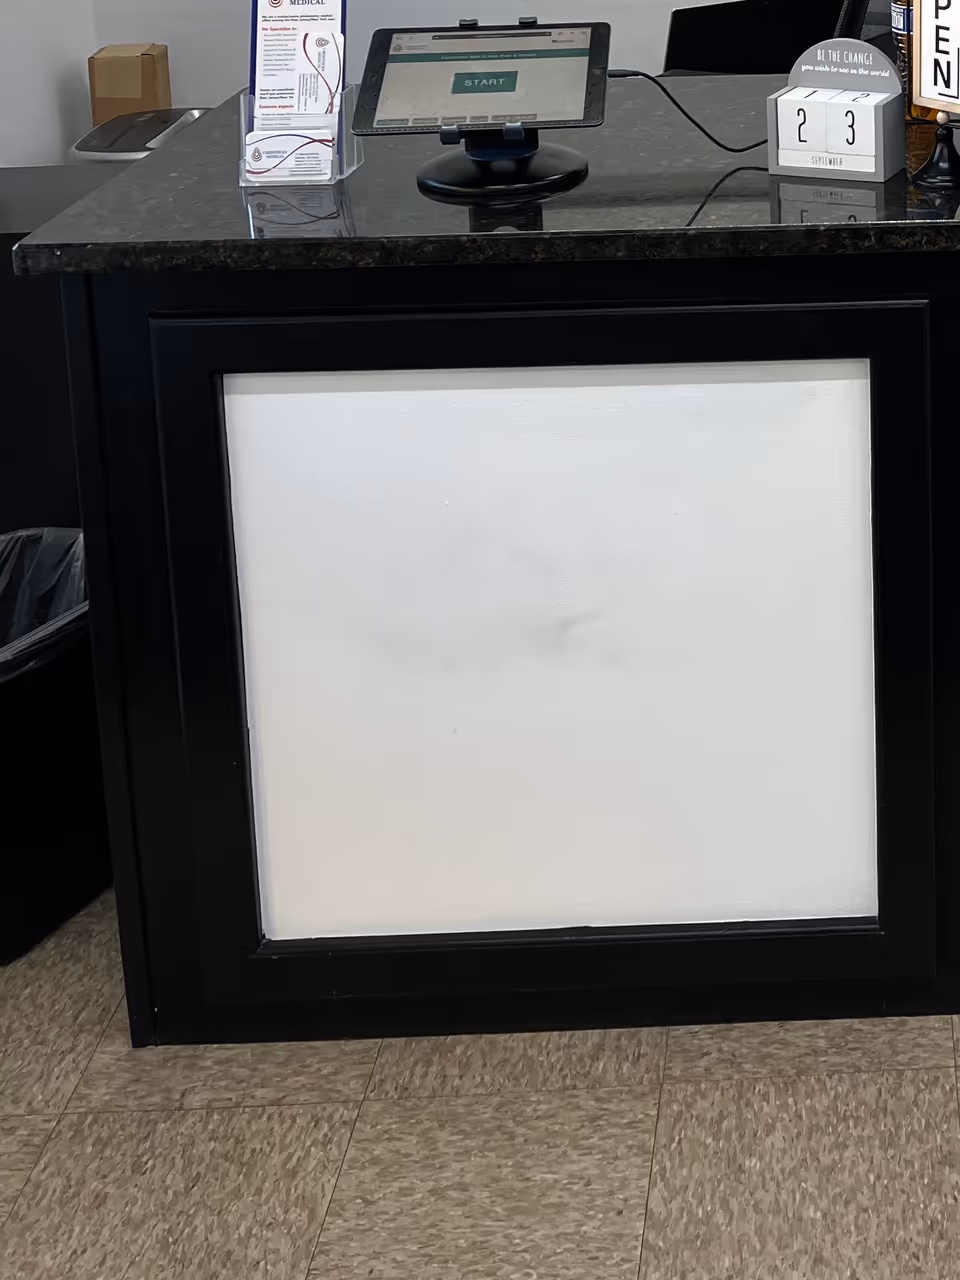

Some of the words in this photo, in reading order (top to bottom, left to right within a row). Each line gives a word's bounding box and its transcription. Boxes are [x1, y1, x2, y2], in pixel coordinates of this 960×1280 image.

[817, 49, 825, 61] BE
[828, 50, 840, 62] THE
[843, 51, 873, 65] CHANGE
[801, 64, 814, 72] you
[858, 67, 869, 75] the
[870, 69, 890, 77] world
[464, 78, 505, 86] START
[797, 108, 807, 143] 2
[845, 110, 856, 145] 3
[811, 156, 842, 166] SEPTEMBER
